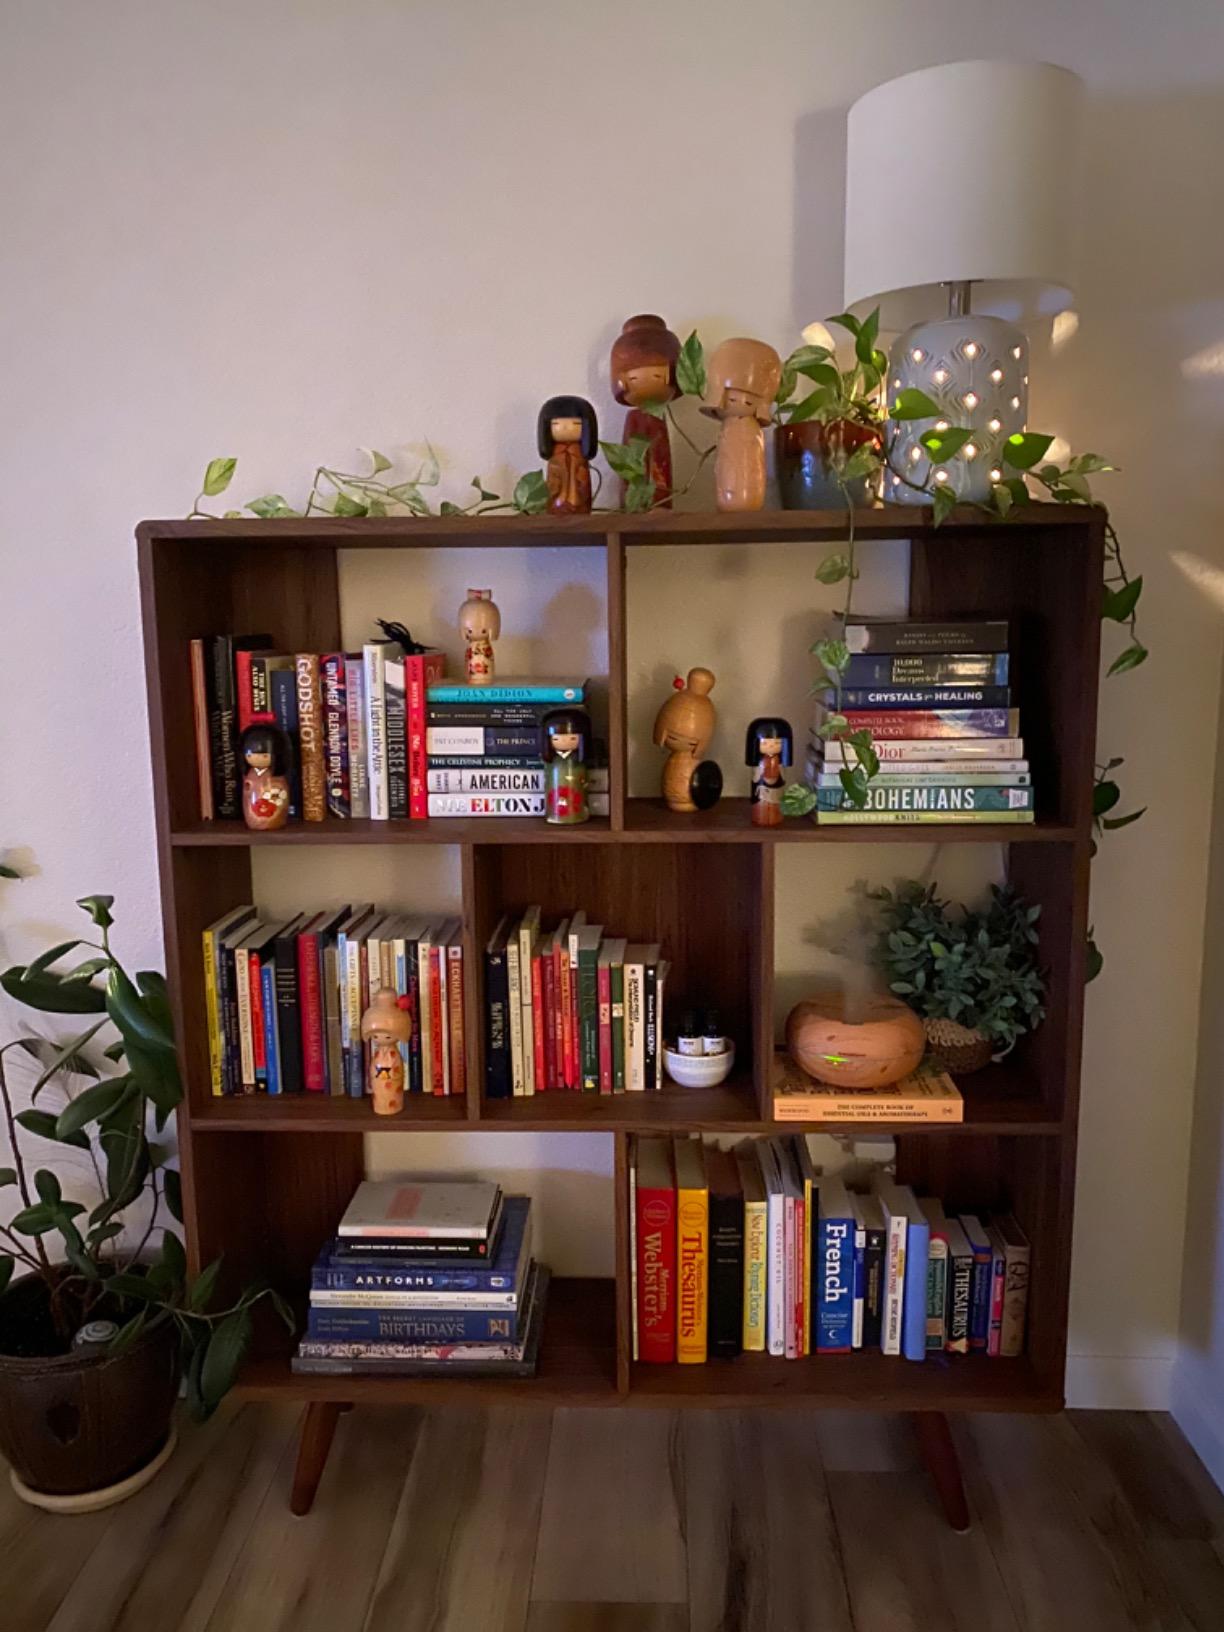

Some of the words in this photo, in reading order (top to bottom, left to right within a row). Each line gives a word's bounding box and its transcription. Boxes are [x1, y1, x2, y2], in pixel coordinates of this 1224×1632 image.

[326, 661, 338, 706] UNTAMED
[457, 689, 486, 698] JOAN
[490, 689, 533, 698] DIDION
[892, 672, 940, 684] Interpreted
[298, 659, 317, 753] GODSHOT
[868, 692, 923, 702] CRYSTALS
[934, 691, 983, 701] HEALING
[221, 710, 233, 751] Women
[328, 712, 341, 754] GLENNON
[387, 705, 406, 774] MIDDLESEX
[496, 738, 511, 746] THE
[224, 752, 235, 779] Who
[330, 755, 343, 784] DOYLE
[431, 758, 446, 766] THE
[446, 758, 483, 766] CELESTINE
[484, 758, 521, 766] PROPHECY
[225, 780, 237, 802] Run
[469, 774, 541, 790] AMERICAN
[470, 798, 532, 813] ELTON
[450, 961, 462, 1006] ECKHART
[775, 1223, 783, 1265] COCONUT
[748, 1261, 764, 1292] Rhyming
[775, 1269, 783, 1285] OIL
[825, 1223, 846, 1302] French
[355, 1275, 435, 1286] ARTFORMS
[644, 1231, 663, 1327] Webster's
[659, 1268, 670, 1311] Merriam
[681, 1231, 703, 1338] Thesaurus
[747, 1292, 763, 1328] Dictionary
[952, 1269, 970, 1337] THESAURUS
[378, 1321, 465, 1337] BIRTHDAYS
